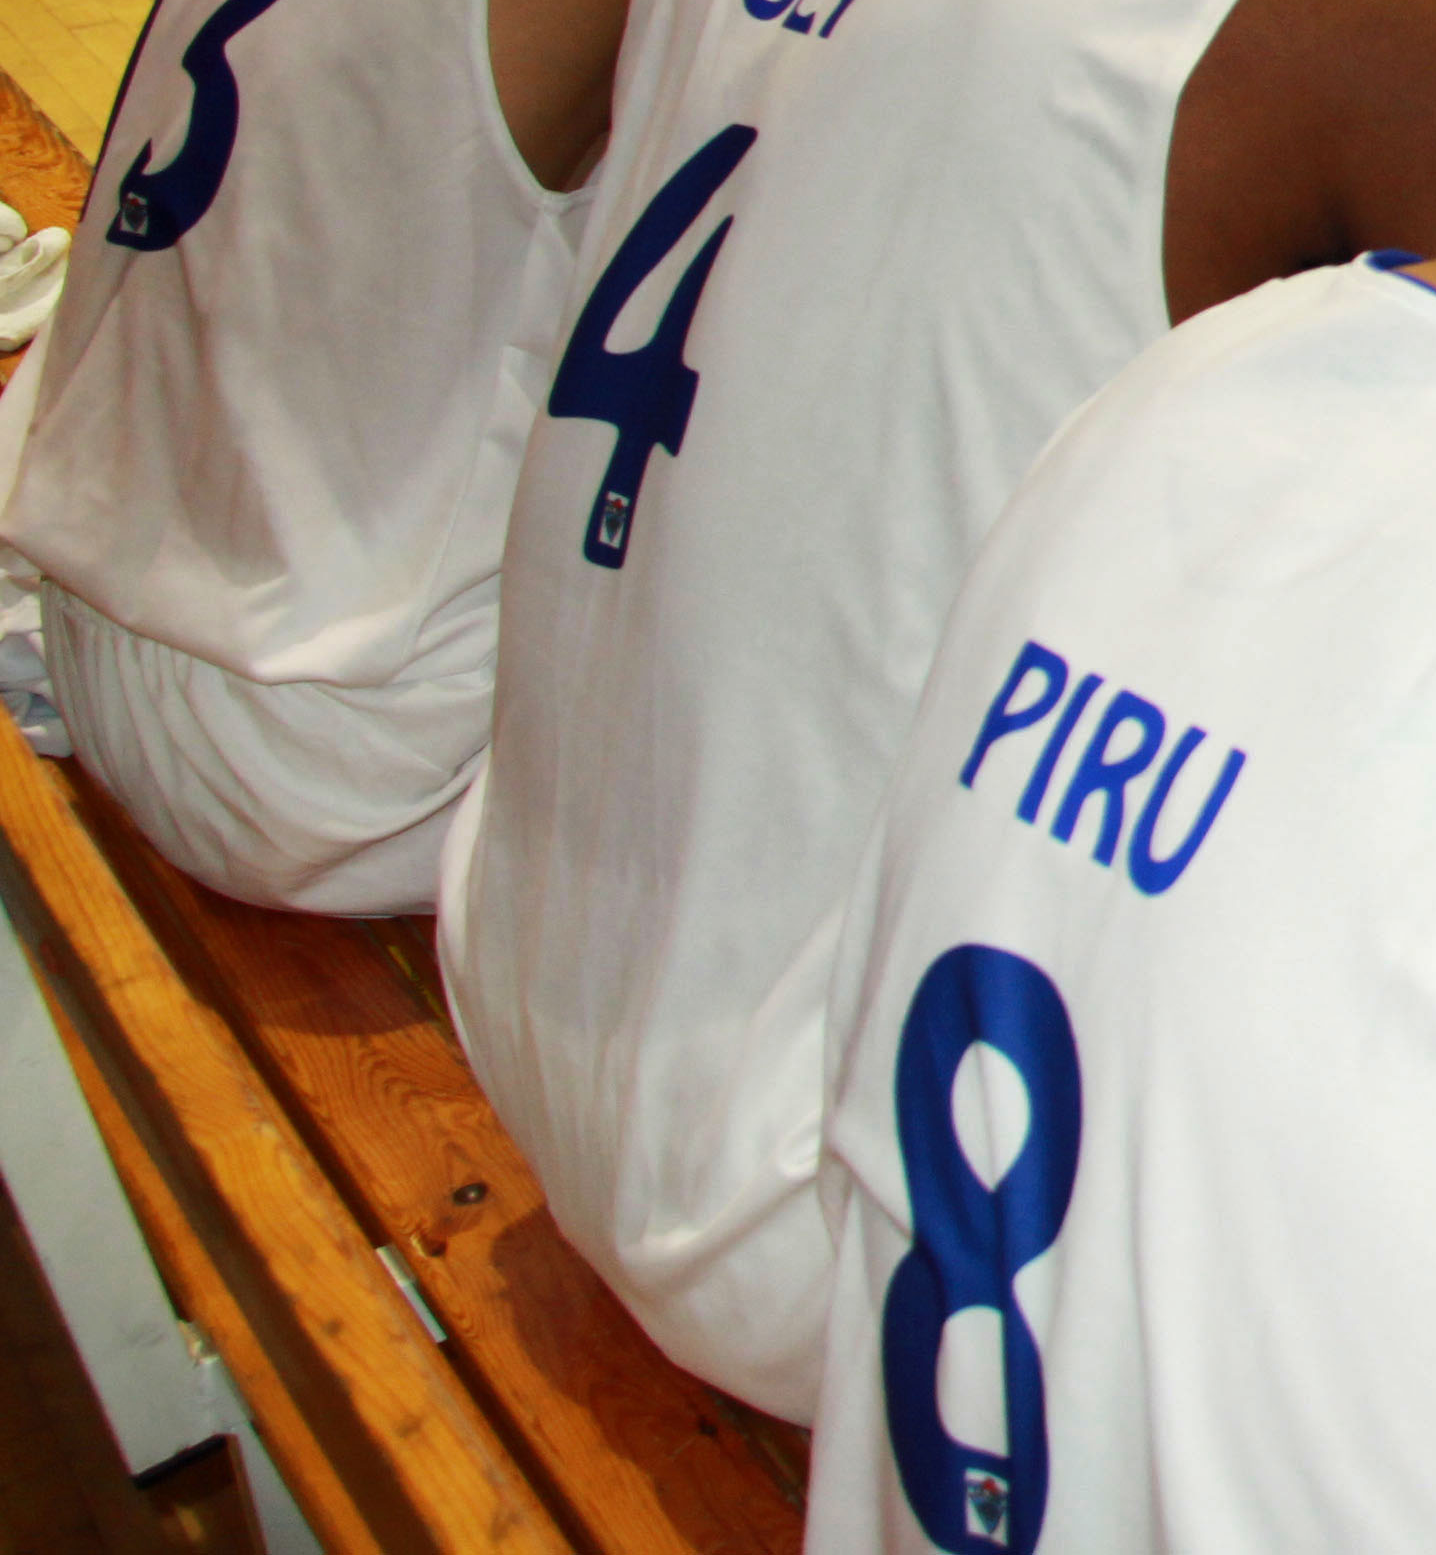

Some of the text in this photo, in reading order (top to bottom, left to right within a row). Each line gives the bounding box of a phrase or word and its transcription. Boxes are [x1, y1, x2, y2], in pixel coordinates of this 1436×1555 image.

[547, 123, 758, 571] 4
[957, 638, 1248, 899] PIRU
[880, 941, 1084, 1555] 8
